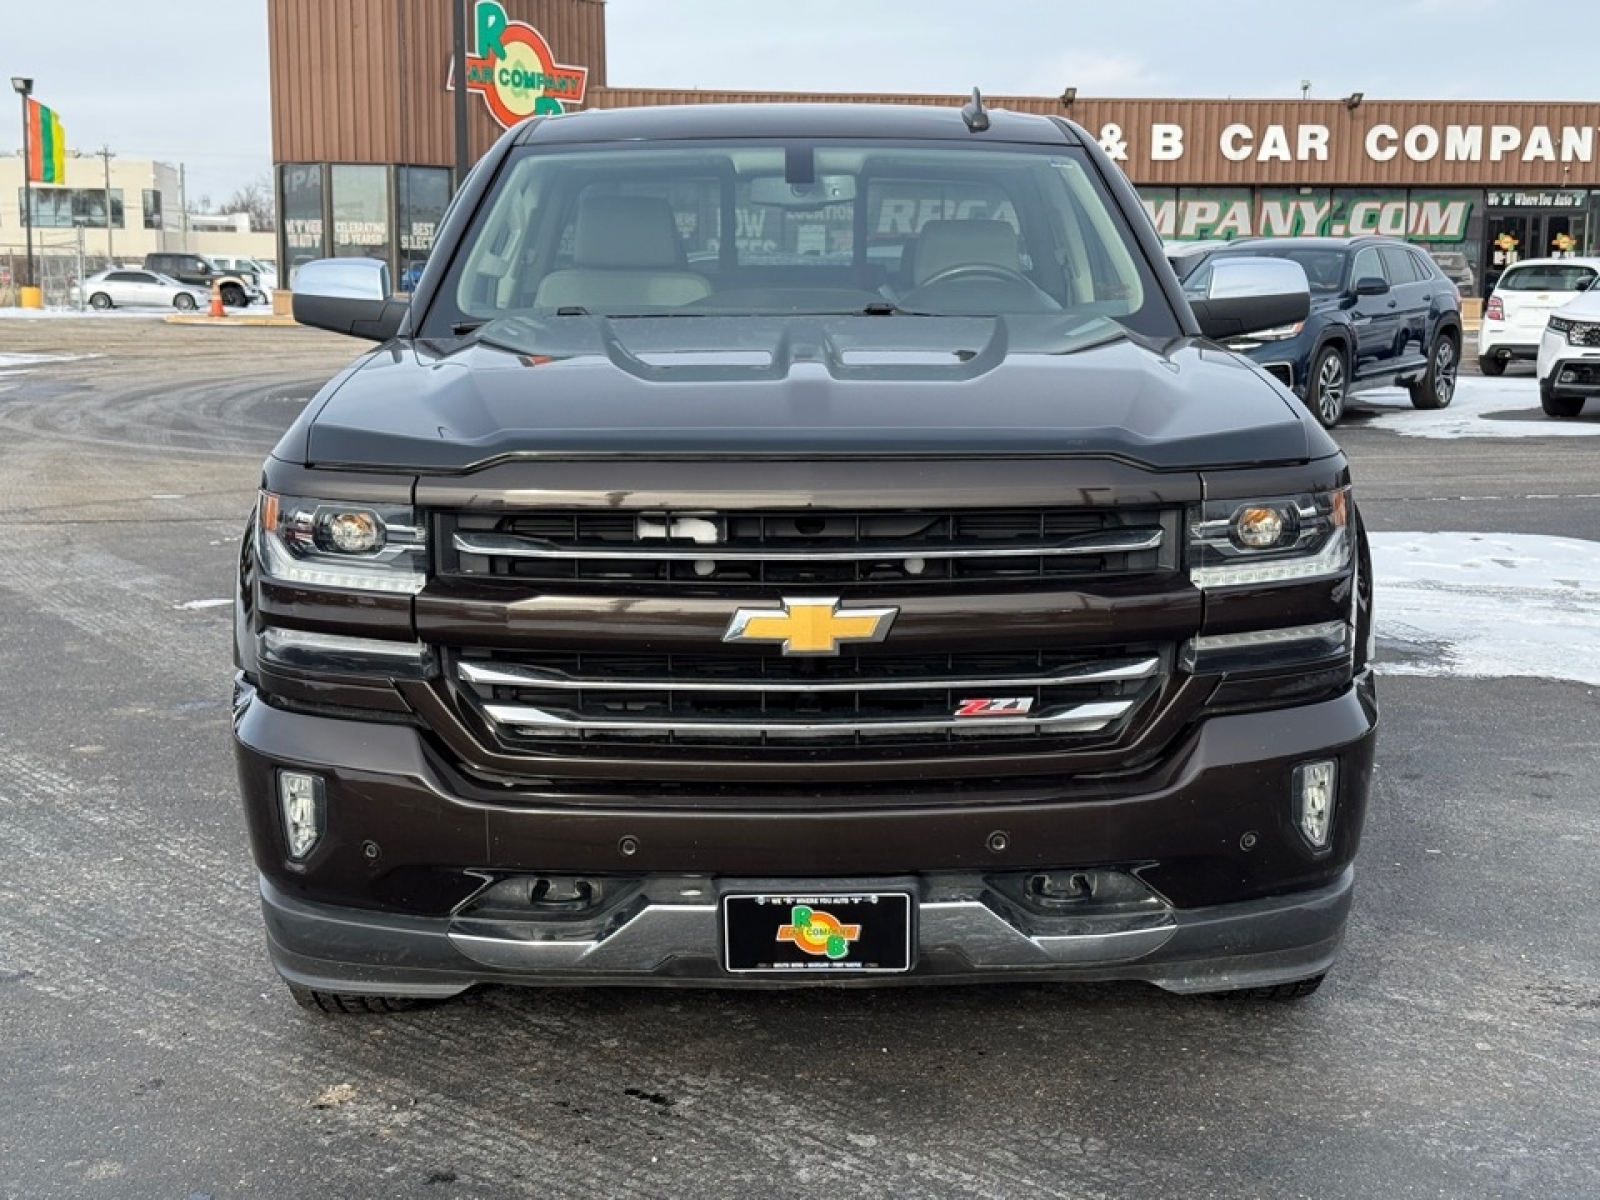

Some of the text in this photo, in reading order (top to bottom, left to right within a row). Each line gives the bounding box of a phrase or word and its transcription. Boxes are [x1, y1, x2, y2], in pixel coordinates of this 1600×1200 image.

[476, 1, 508, 60] R
[467, 65, 581, 94] AR COMPANY
[1151, 124, 1184, 160] B
[1219, 123, 1330, 161] CAR
[1365, 124, 1600, 162] COMPAN
[412, 222, 436, 235] BEST
[954, 697, 1034, 716] Z71
[793, 906, 812, 929] R
[827, 937, 847, 957] B
